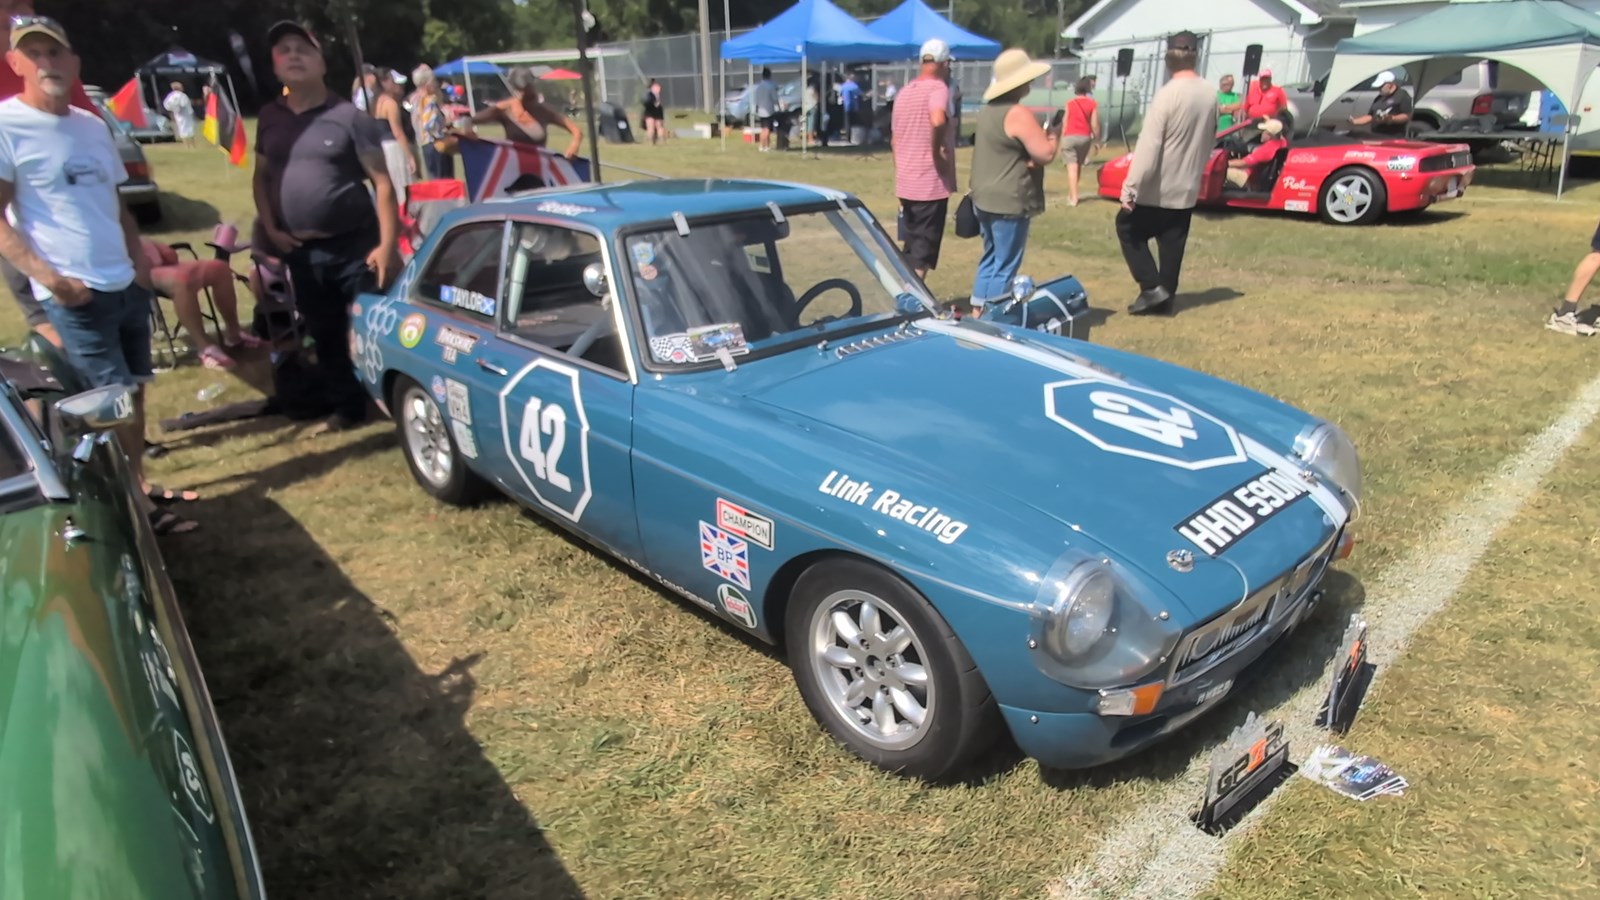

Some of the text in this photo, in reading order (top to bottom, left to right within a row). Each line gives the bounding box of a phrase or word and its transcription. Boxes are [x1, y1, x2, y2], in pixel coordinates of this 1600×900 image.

[451, 286, 484, 312] TAYLOR
[519, 396, 572, 493] 42
[1089, 390, 1199, 449] 42
[722, 510, 769, 539] CHAMPION
[818, 470, 968, 545] Link Racing
[1178, 499, 1255, 556] HHD
[716, 547, 733, 564] BP
